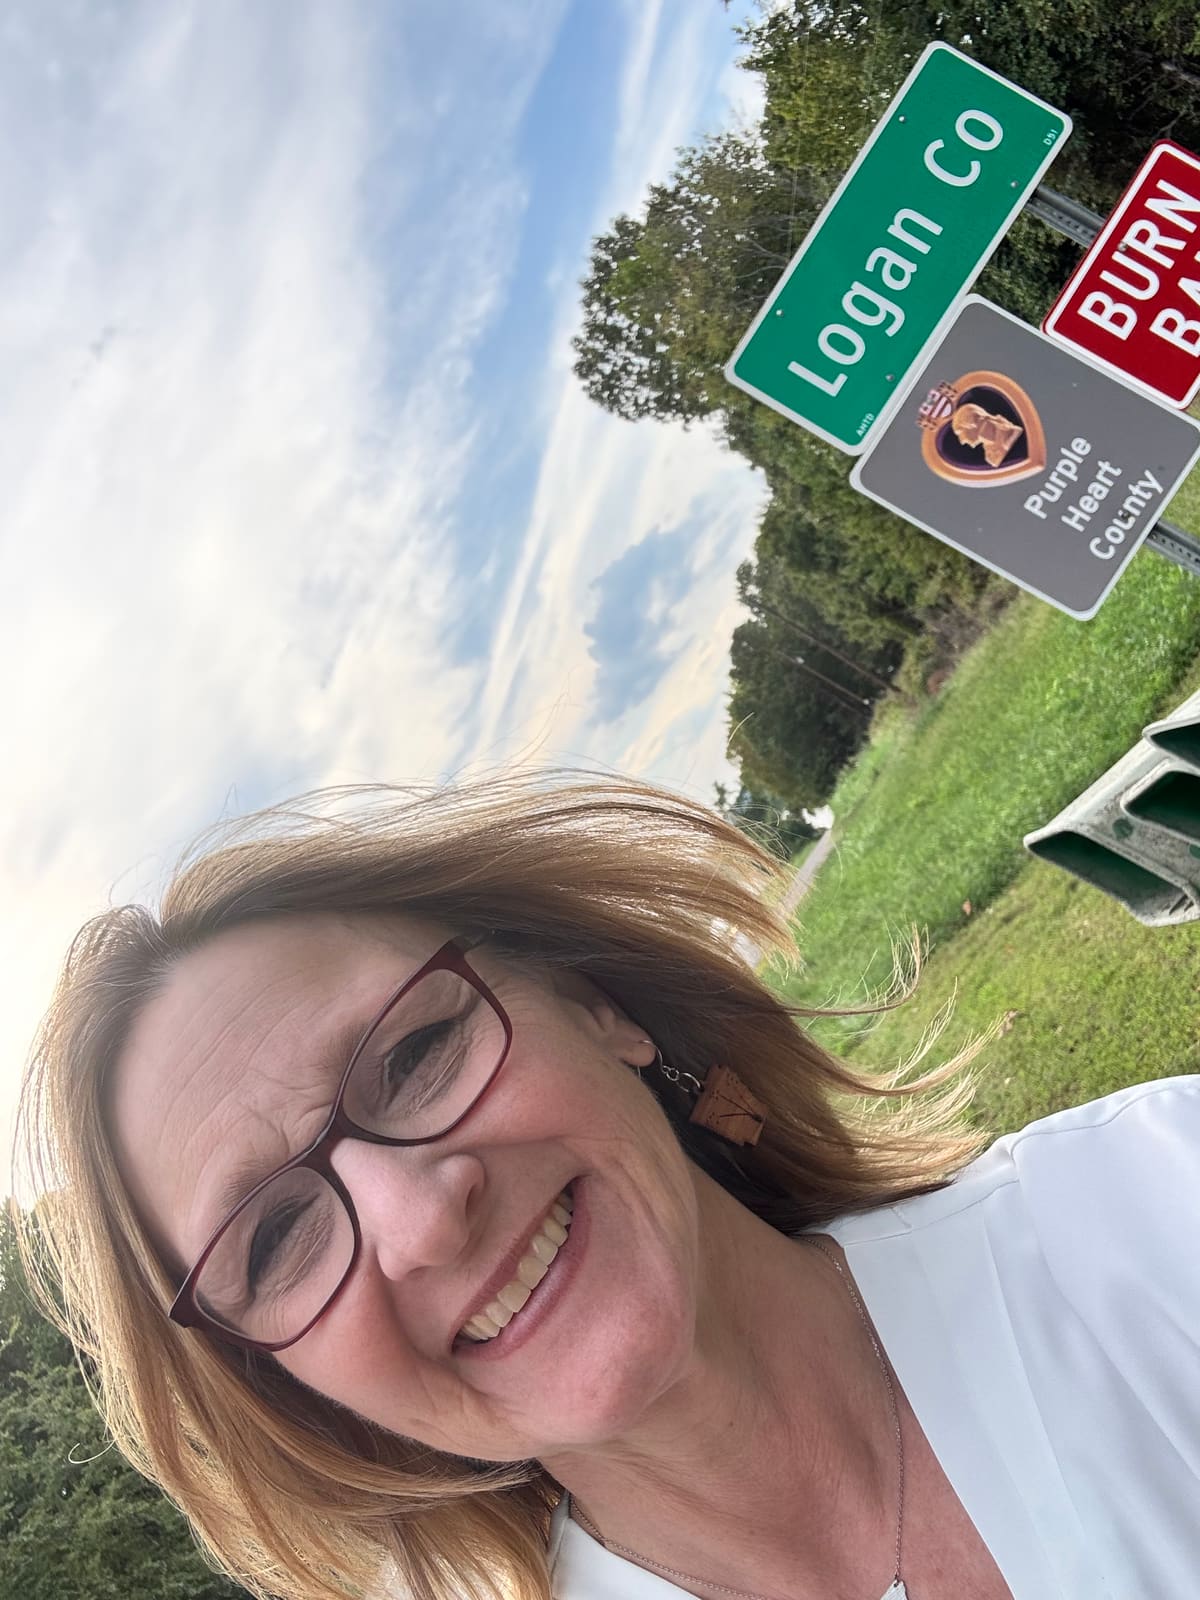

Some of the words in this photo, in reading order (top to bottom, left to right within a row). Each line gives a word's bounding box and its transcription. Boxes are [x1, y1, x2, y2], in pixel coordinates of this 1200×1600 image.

[787, 208, 943, 397] Logan
[924, 109, 1004, 187] Co
[1077, 179, 1200, 341] BURN
[1023, 437, 1092, 519] Purple
[1061, 460, 1122, 532] Heart
[1089, 469, 1164, 560] County
